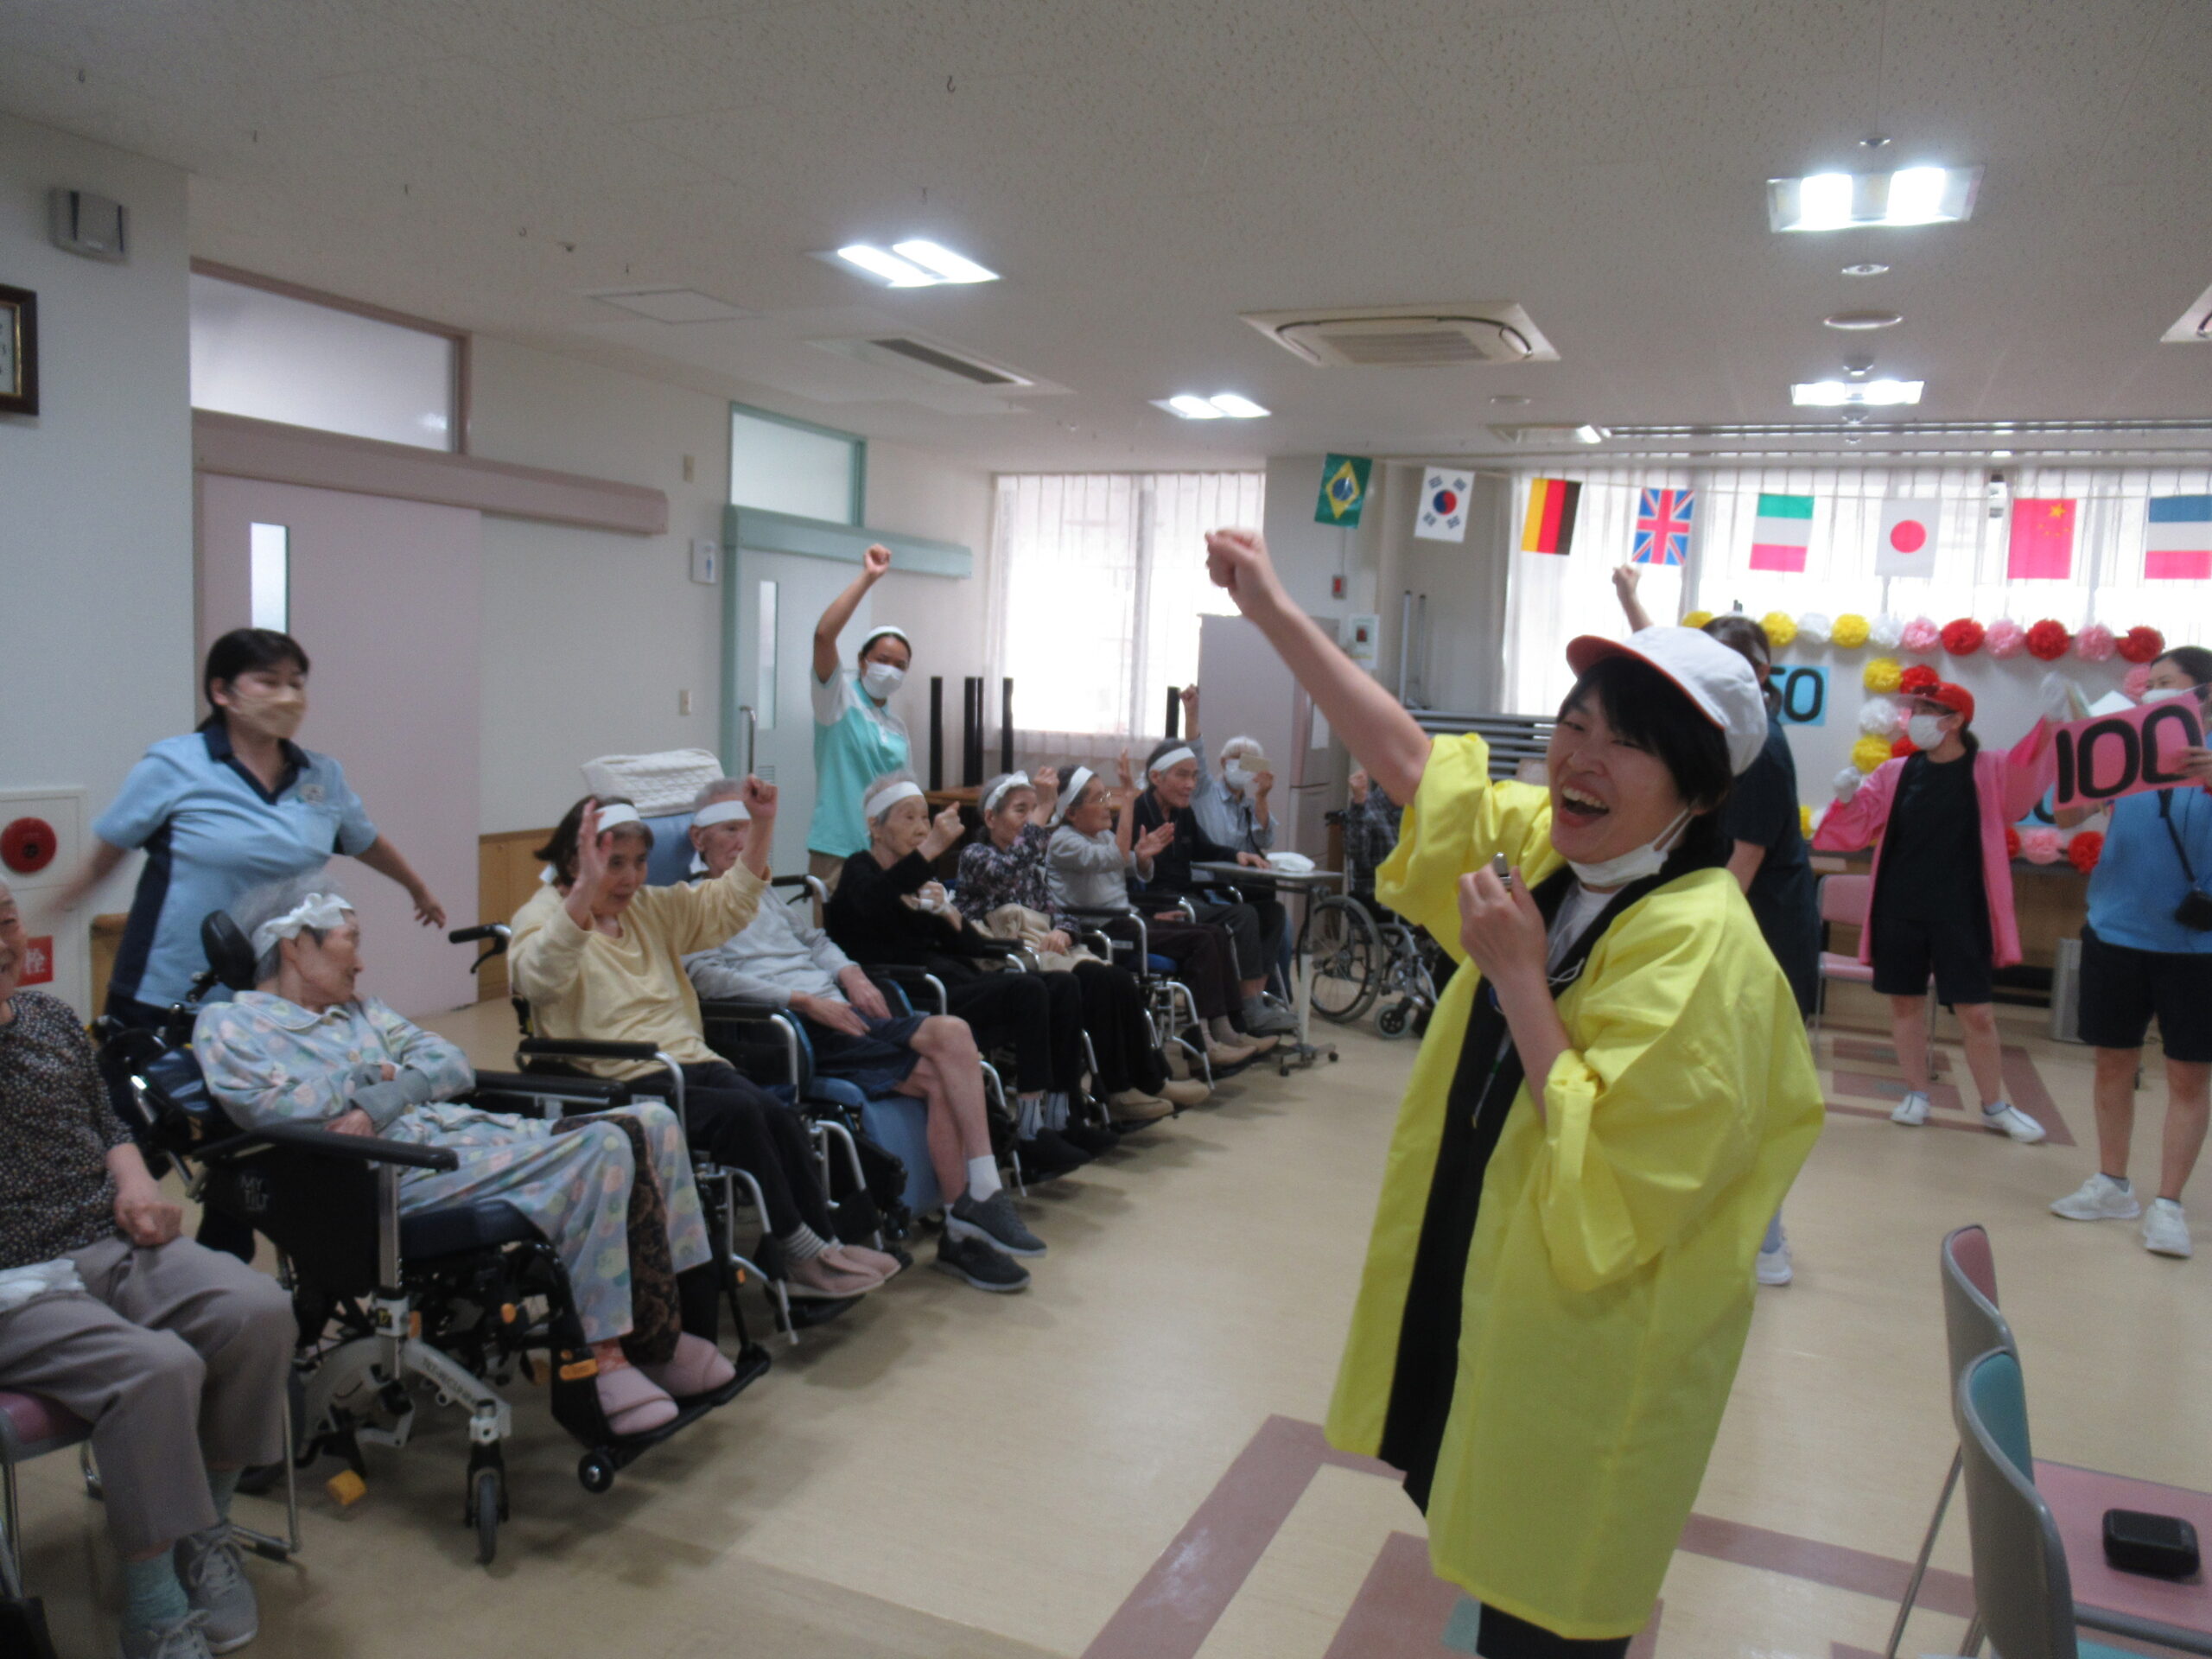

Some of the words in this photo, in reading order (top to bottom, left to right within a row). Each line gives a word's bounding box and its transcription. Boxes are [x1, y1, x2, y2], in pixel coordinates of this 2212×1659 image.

[1770, 667, 1825, 722] 0
[2056, 704, 2202, 804] 100
[239, 1173, 264, 1191] MY
[243, 1190, 270, 1211] TILT
